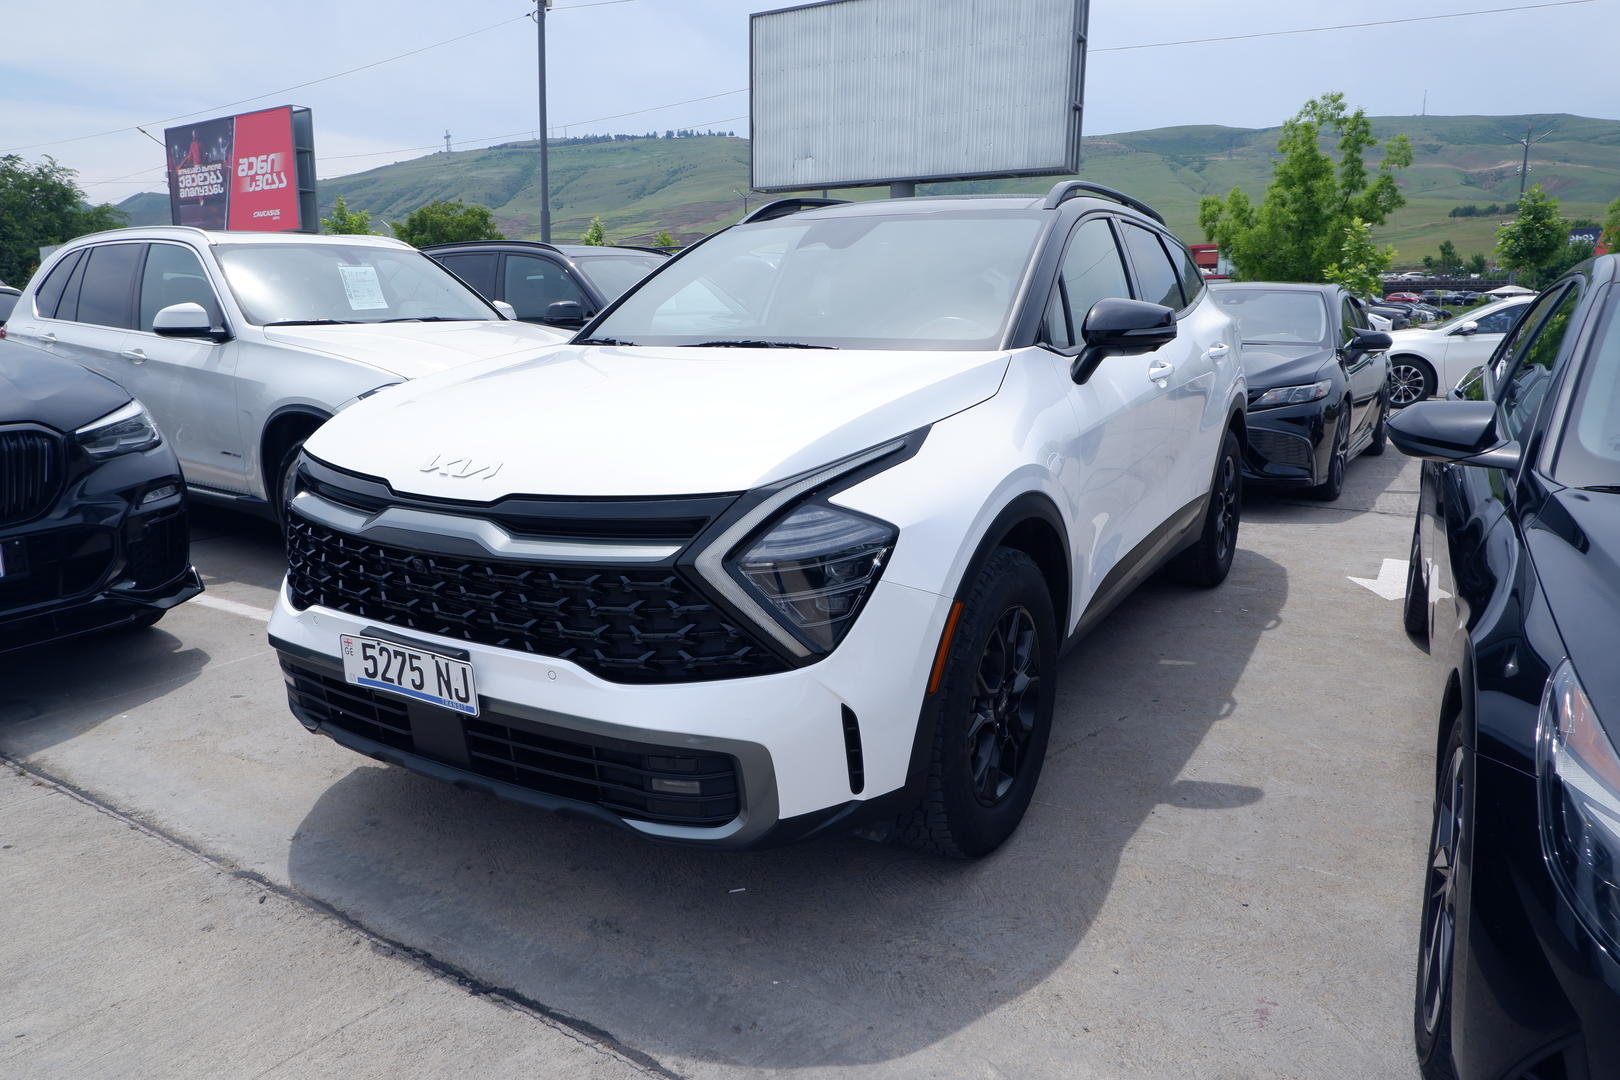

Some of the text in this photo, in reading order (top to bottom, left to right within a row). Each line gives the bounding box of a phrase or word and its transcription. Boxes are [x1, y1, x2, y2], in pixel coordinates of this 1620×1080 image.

[252, 209, 281, 218] CAUCASUS
[344, 646, 354, 657] GE
[361, 642, 470, 704] 5275 NJ
